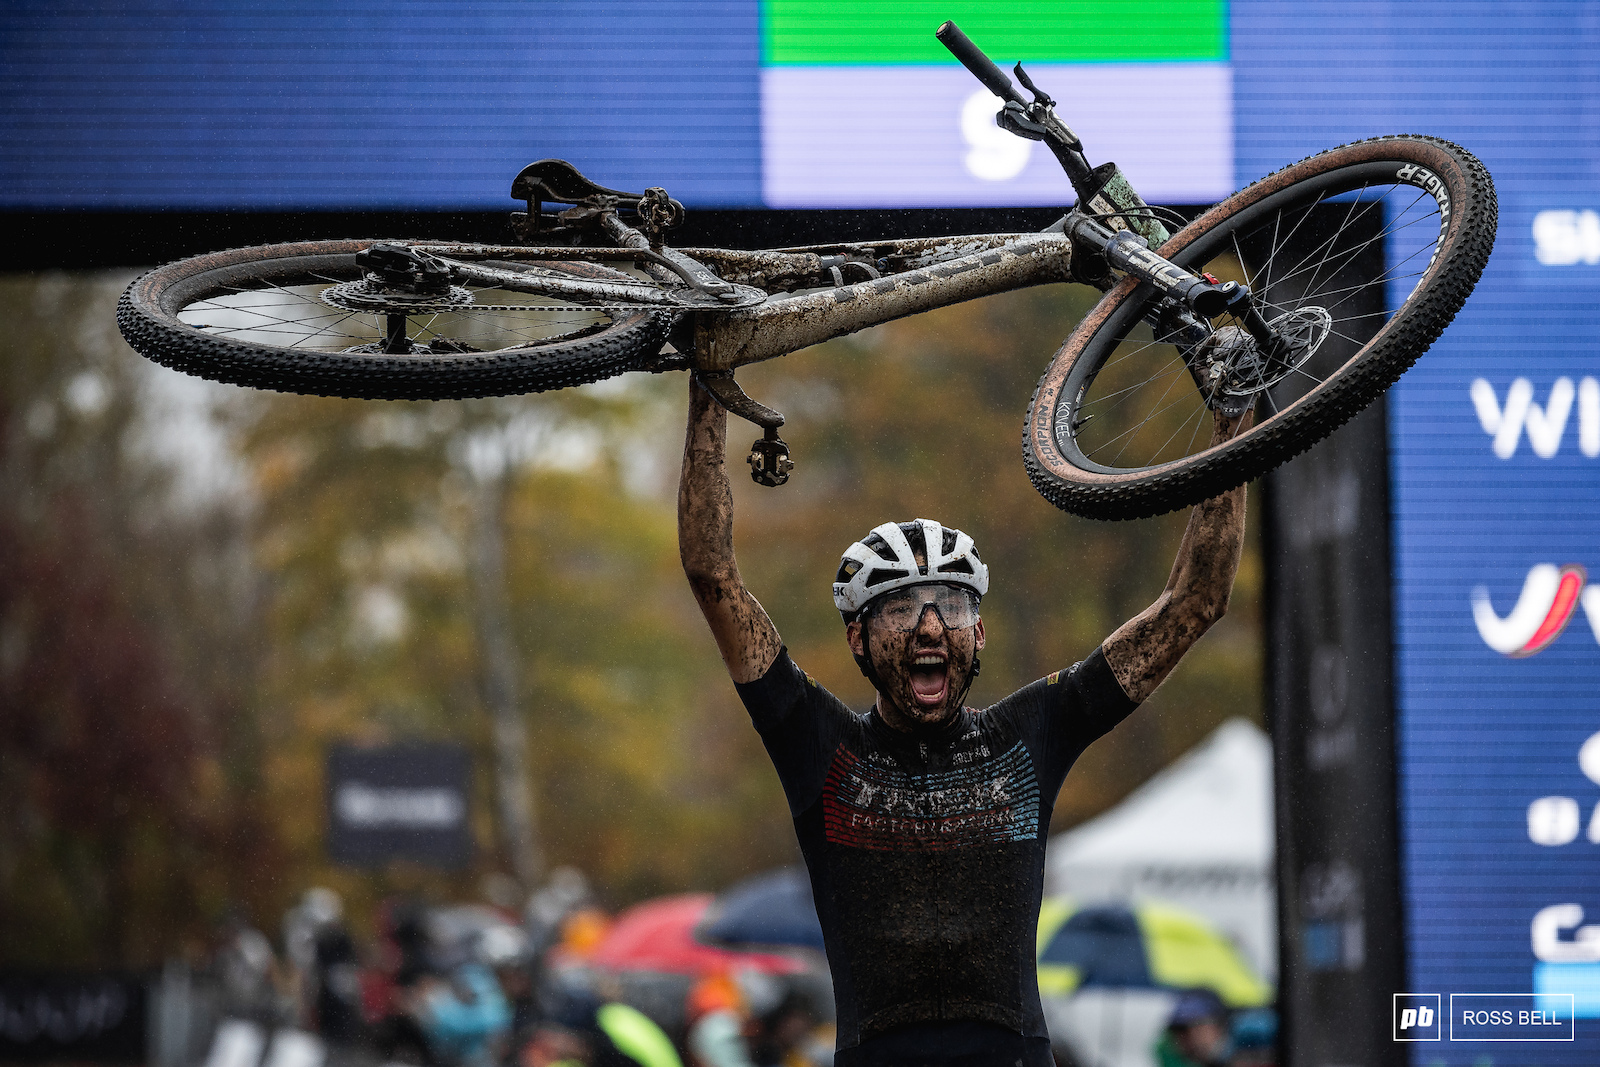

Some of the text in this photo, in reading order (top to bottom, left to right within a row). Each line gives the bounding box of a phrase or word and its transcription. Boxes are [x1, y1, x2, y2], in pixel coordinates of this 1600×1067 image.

[1037, 404, 1064, 467] SCORPION
[1055, 401, 1071, 440] KOVEE
[851, 812, 936, 835] FACTORY
